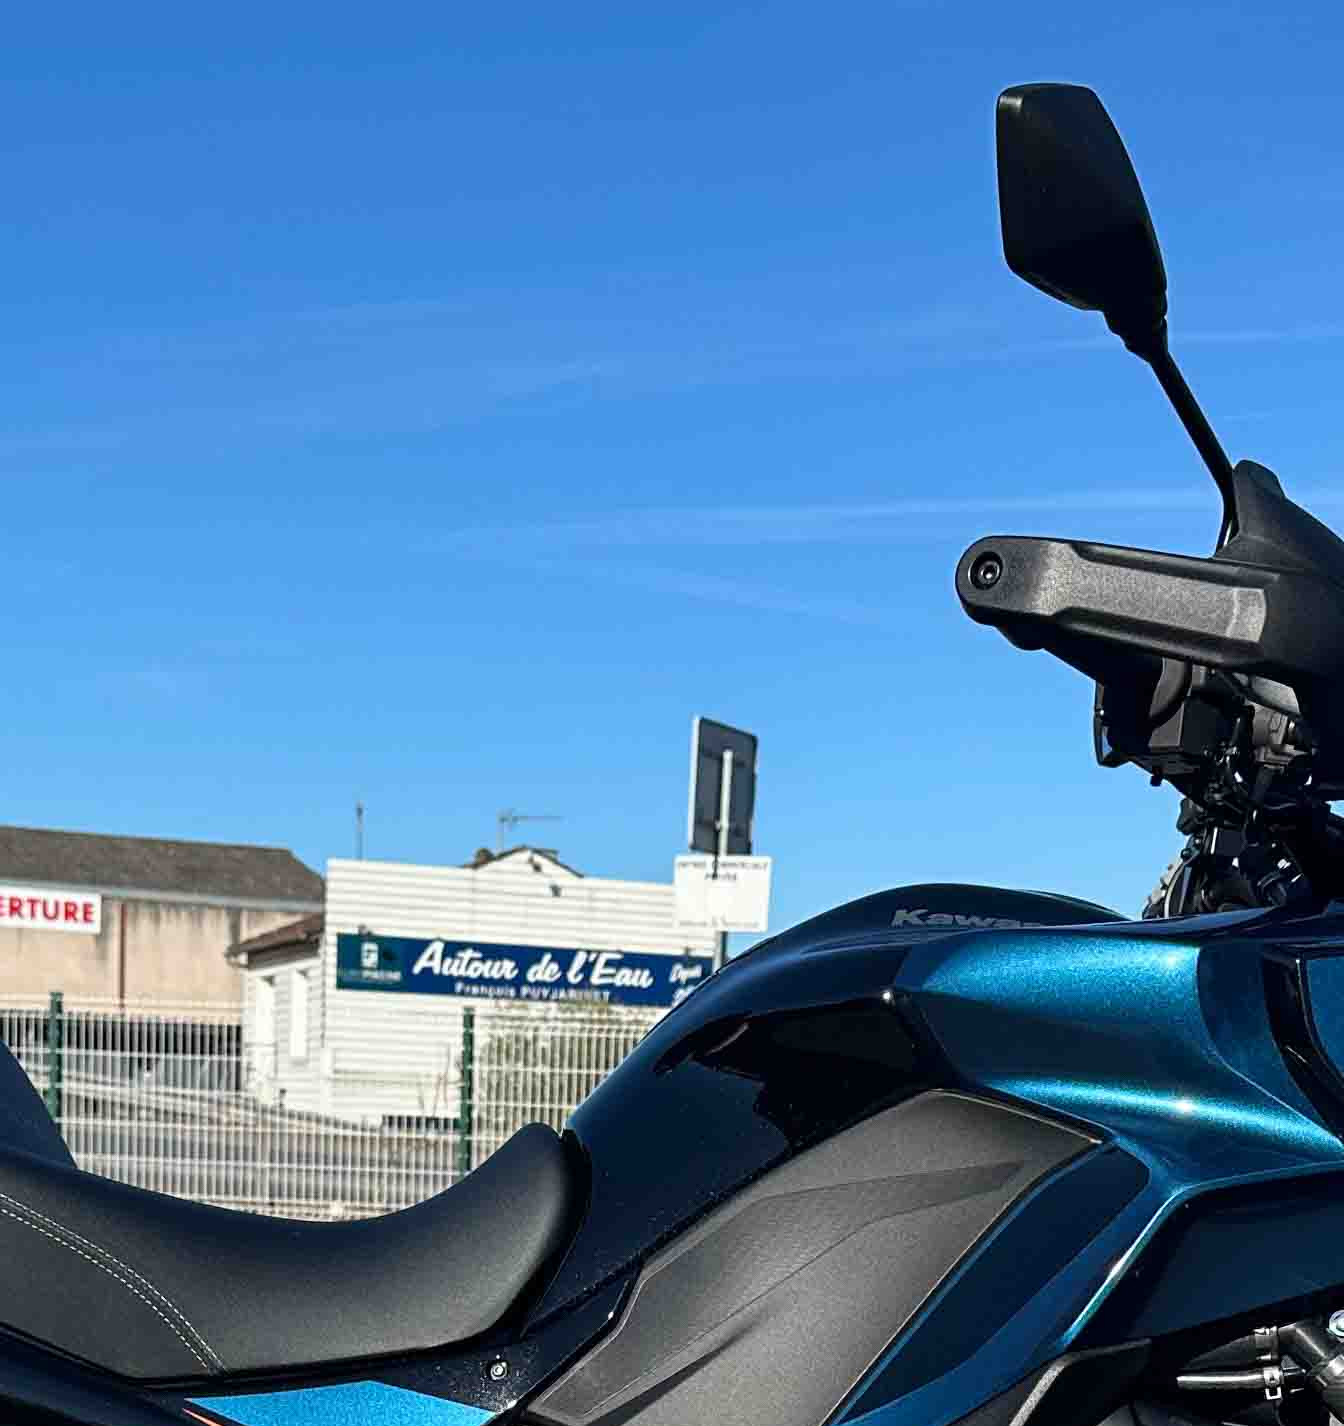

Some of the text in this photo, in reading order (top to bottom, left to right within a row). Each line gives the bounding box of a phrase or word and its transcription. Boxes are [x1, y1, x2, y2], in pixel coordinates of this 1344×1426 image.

[412, 939, 654, 988] Autour de l'Eau
